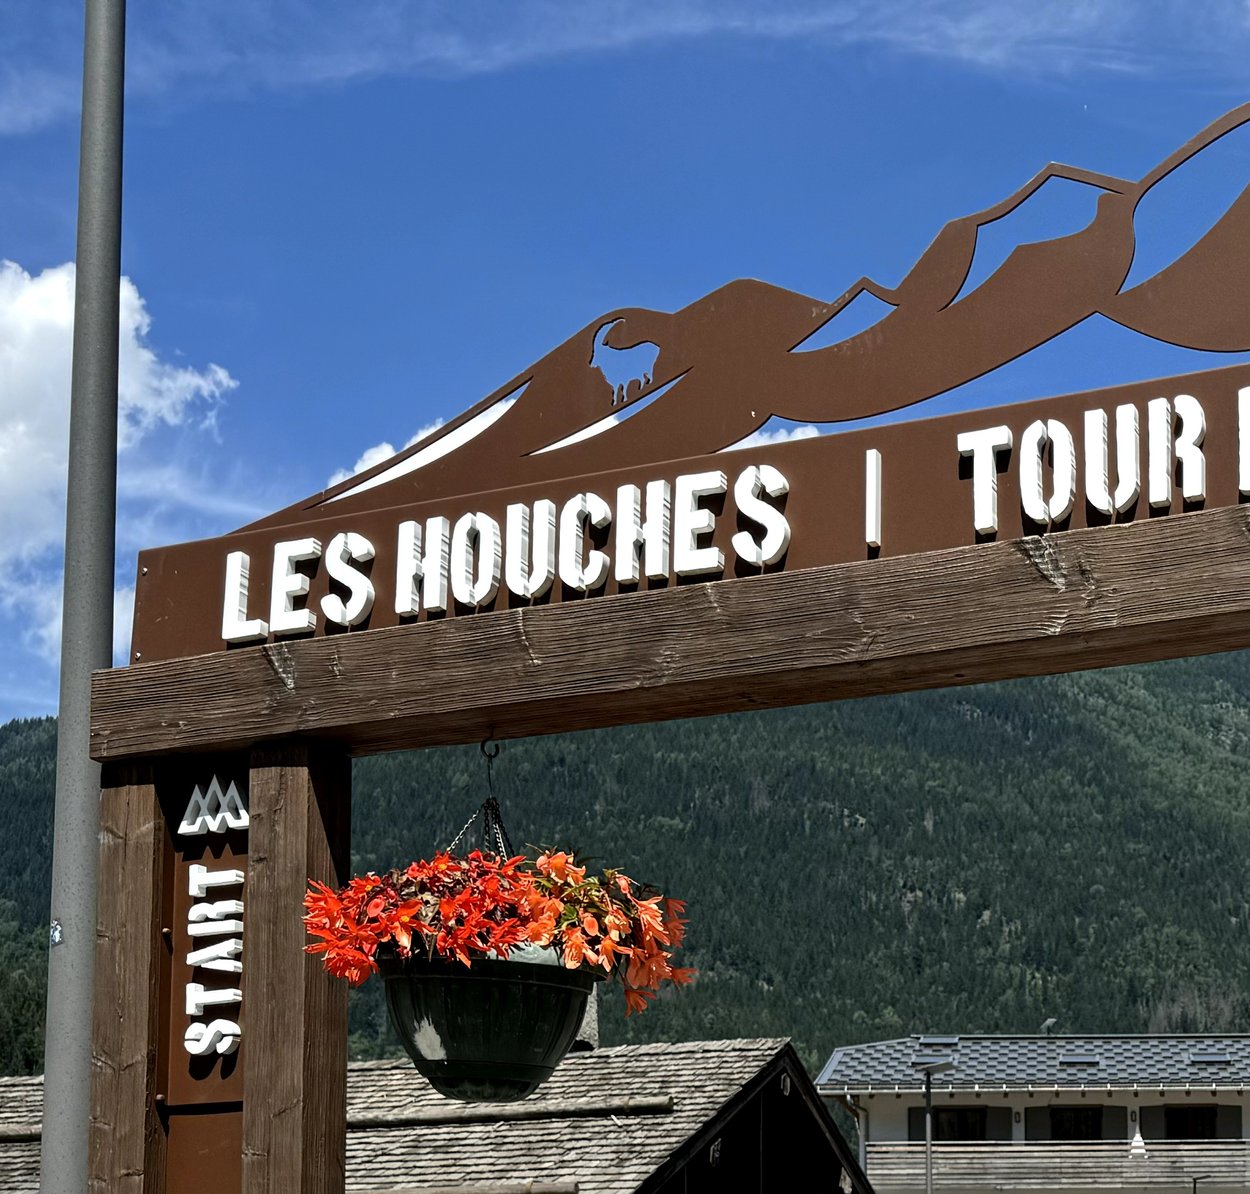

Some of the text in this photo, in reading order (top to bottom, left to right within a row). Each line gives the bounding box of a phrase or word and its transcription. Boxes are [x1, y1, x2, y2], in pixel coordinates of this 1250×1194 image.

[221, 531, 376, 644] LES
[394, 464, 791, 617] HOUCHES
[956, 394, 1207, 536] TOUR
[183, 863, 245, 1056] START
